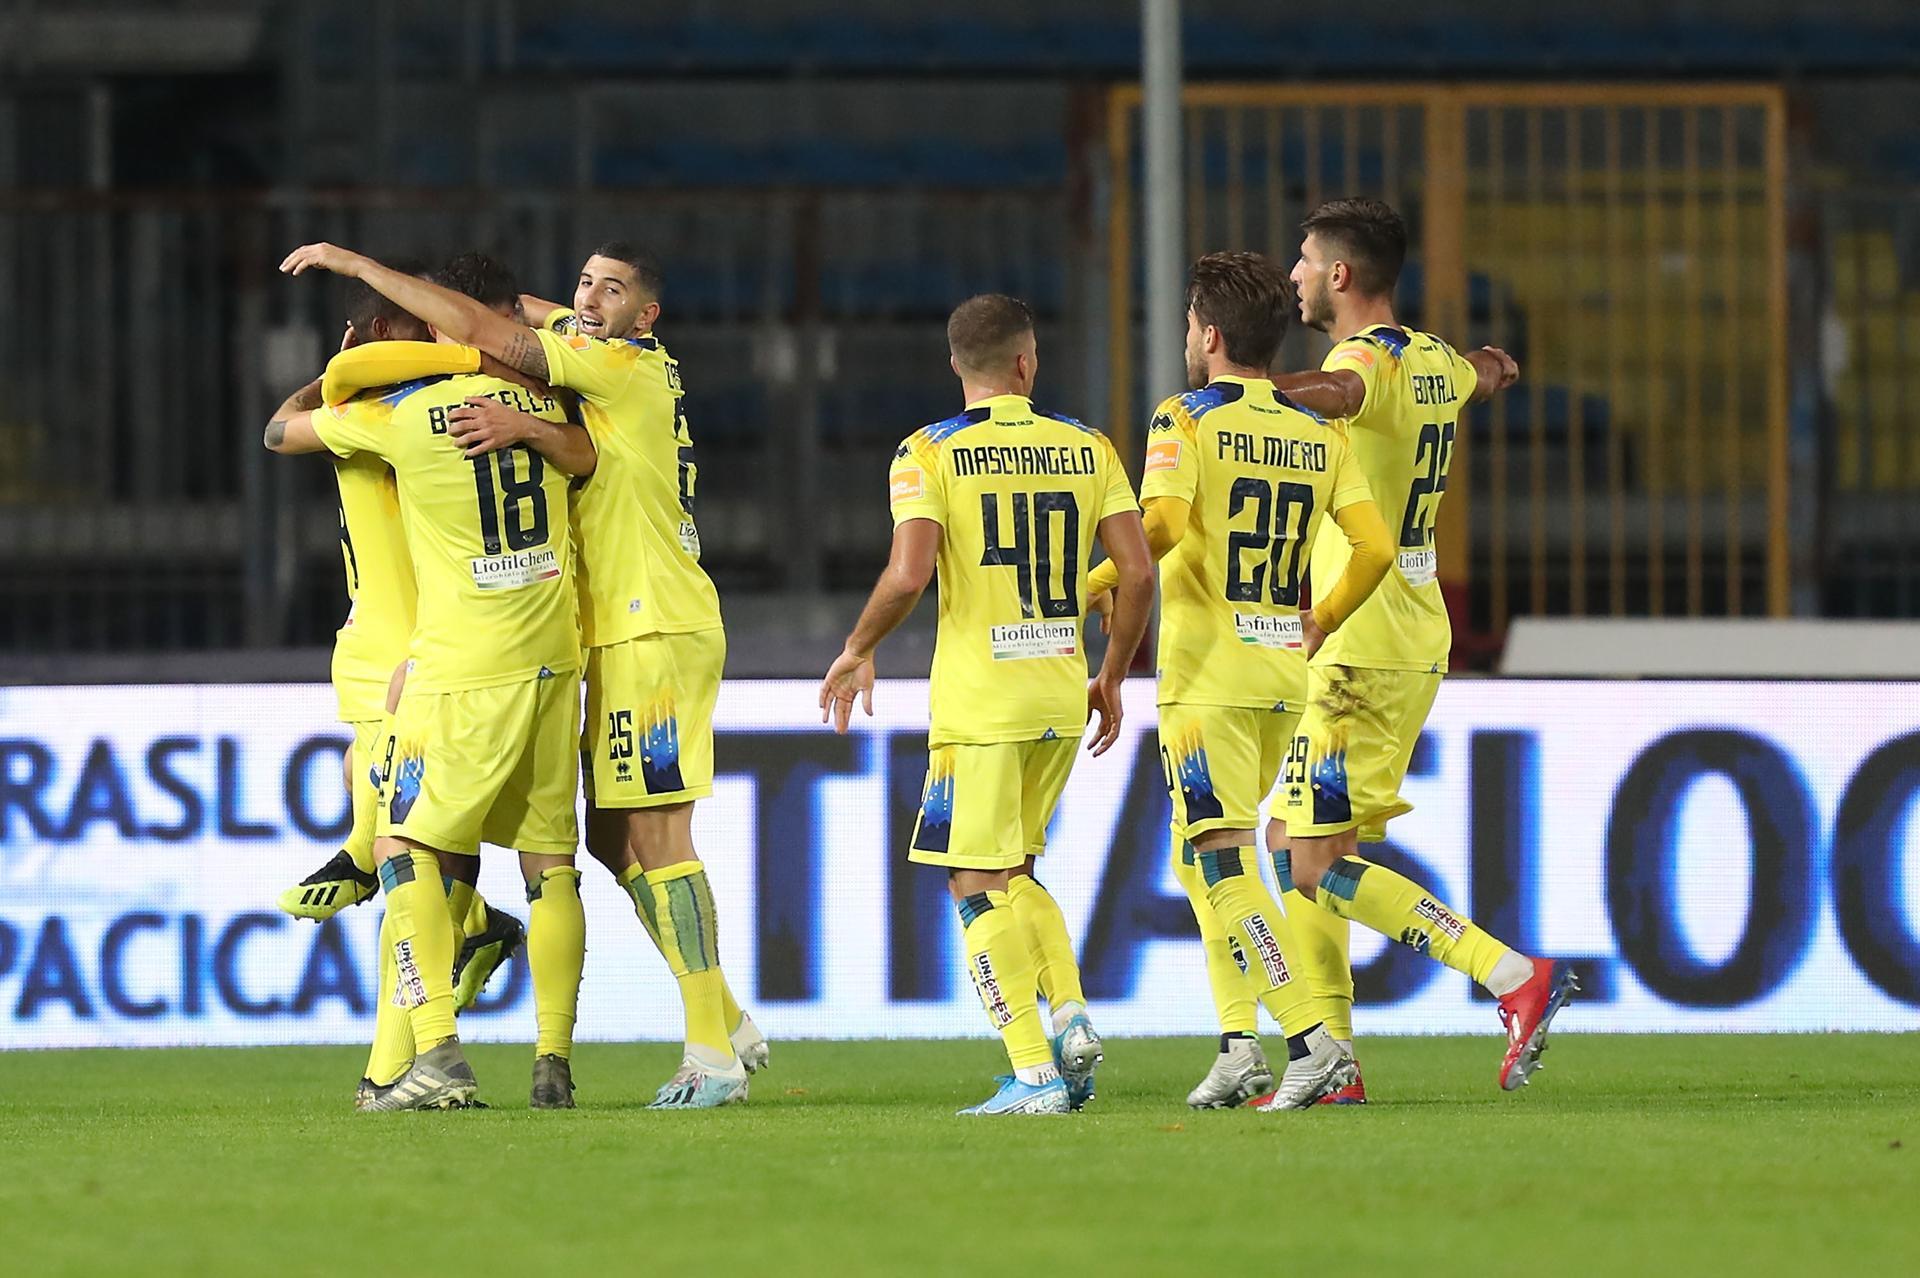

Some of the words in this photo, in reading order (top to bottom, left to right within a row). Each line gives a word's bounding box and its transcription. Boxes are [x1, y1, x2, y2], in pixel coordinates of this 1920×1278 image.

[953, 446, 1095, 476] MASCIANGELO
[1217, 431, 1326, 471] PALMIERO
[464, 440, 550, 555] 18
[472, 551, 555, 575] Liofilchem
[980, 492, 1079, 618] 40
[1226, 477, 1314, 606] 20
[992, 625, 1075, 642] Liofilchem
[609, 710, 633, 760] 25
[1286, 736, 1309, 783] 29
[708, 726, 1920, 1012] TASLO
